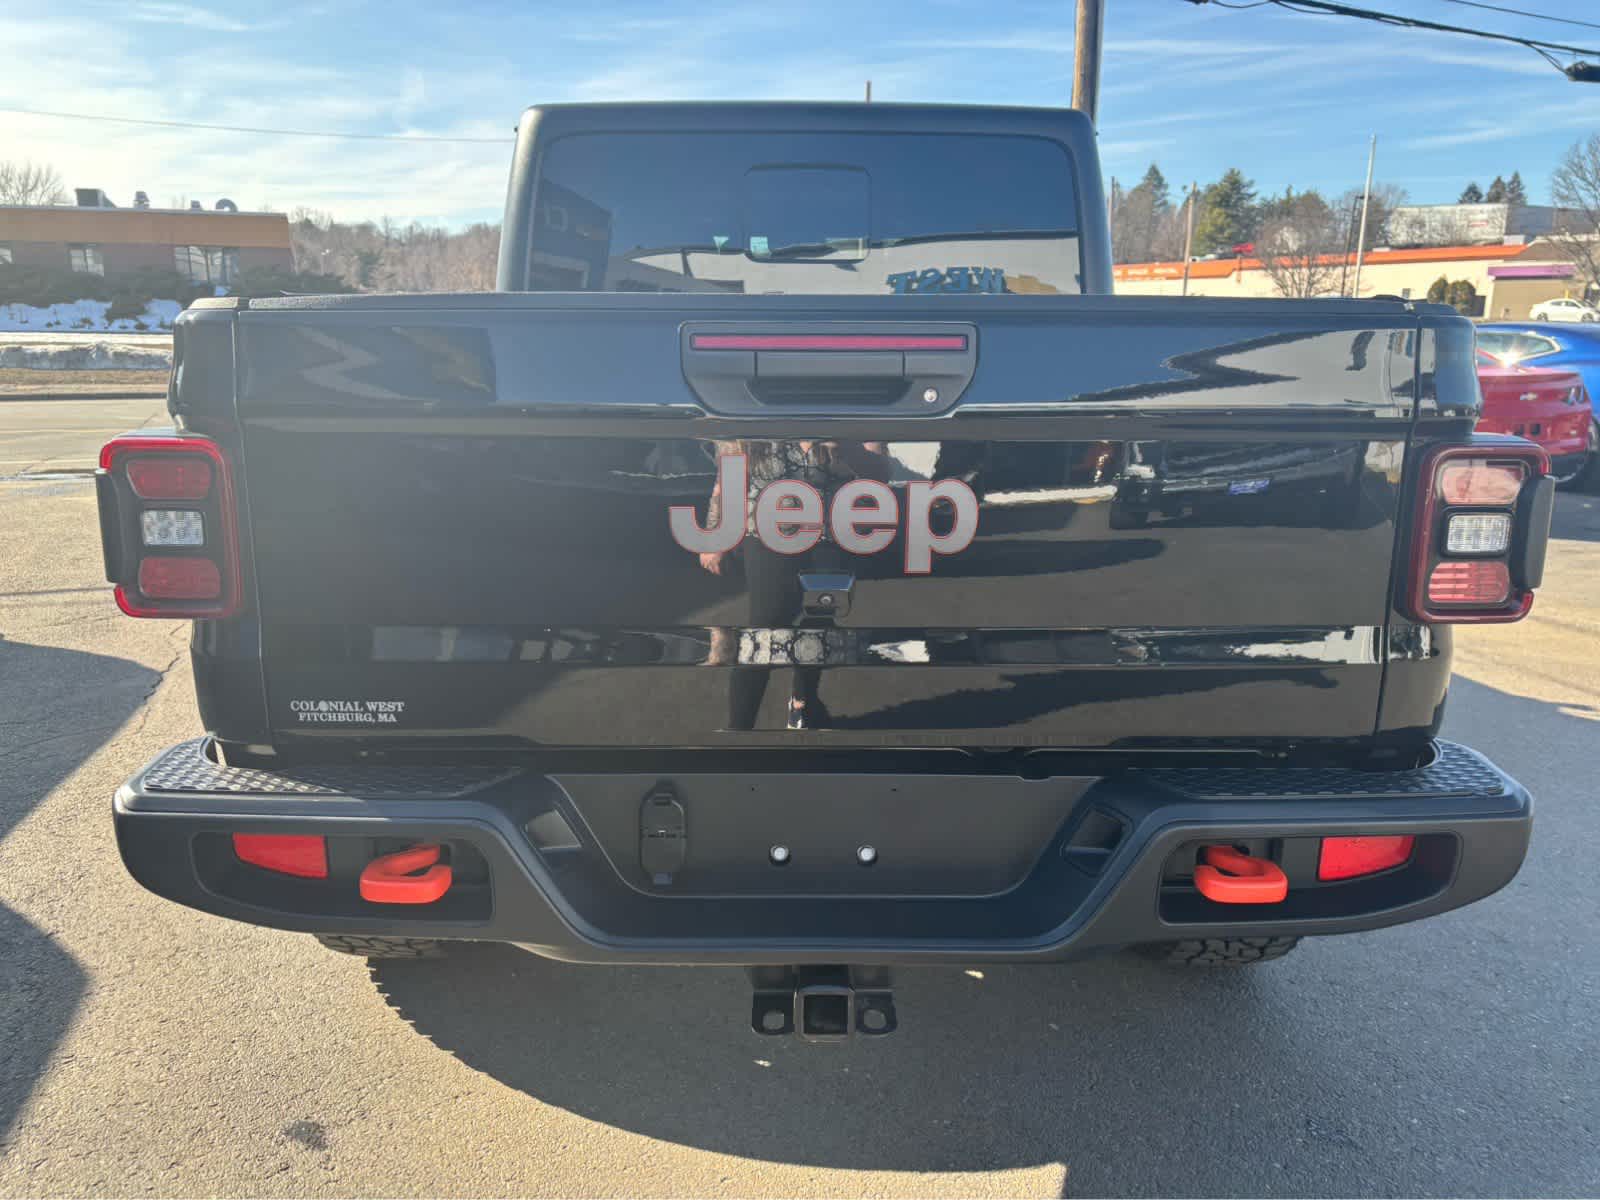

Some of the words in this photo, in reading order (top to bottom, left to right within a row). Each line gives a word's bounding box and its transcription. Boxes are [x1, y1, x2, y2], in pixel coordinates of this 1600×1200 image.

[668, 453, 979, 575] Jeep
[290, 700, 363, 712] COLONIAL
[366, 701, 405, 712] WEST
[298, 712, 376, 723] FITCHBURG,
[378, 713, 397, 722] MA
